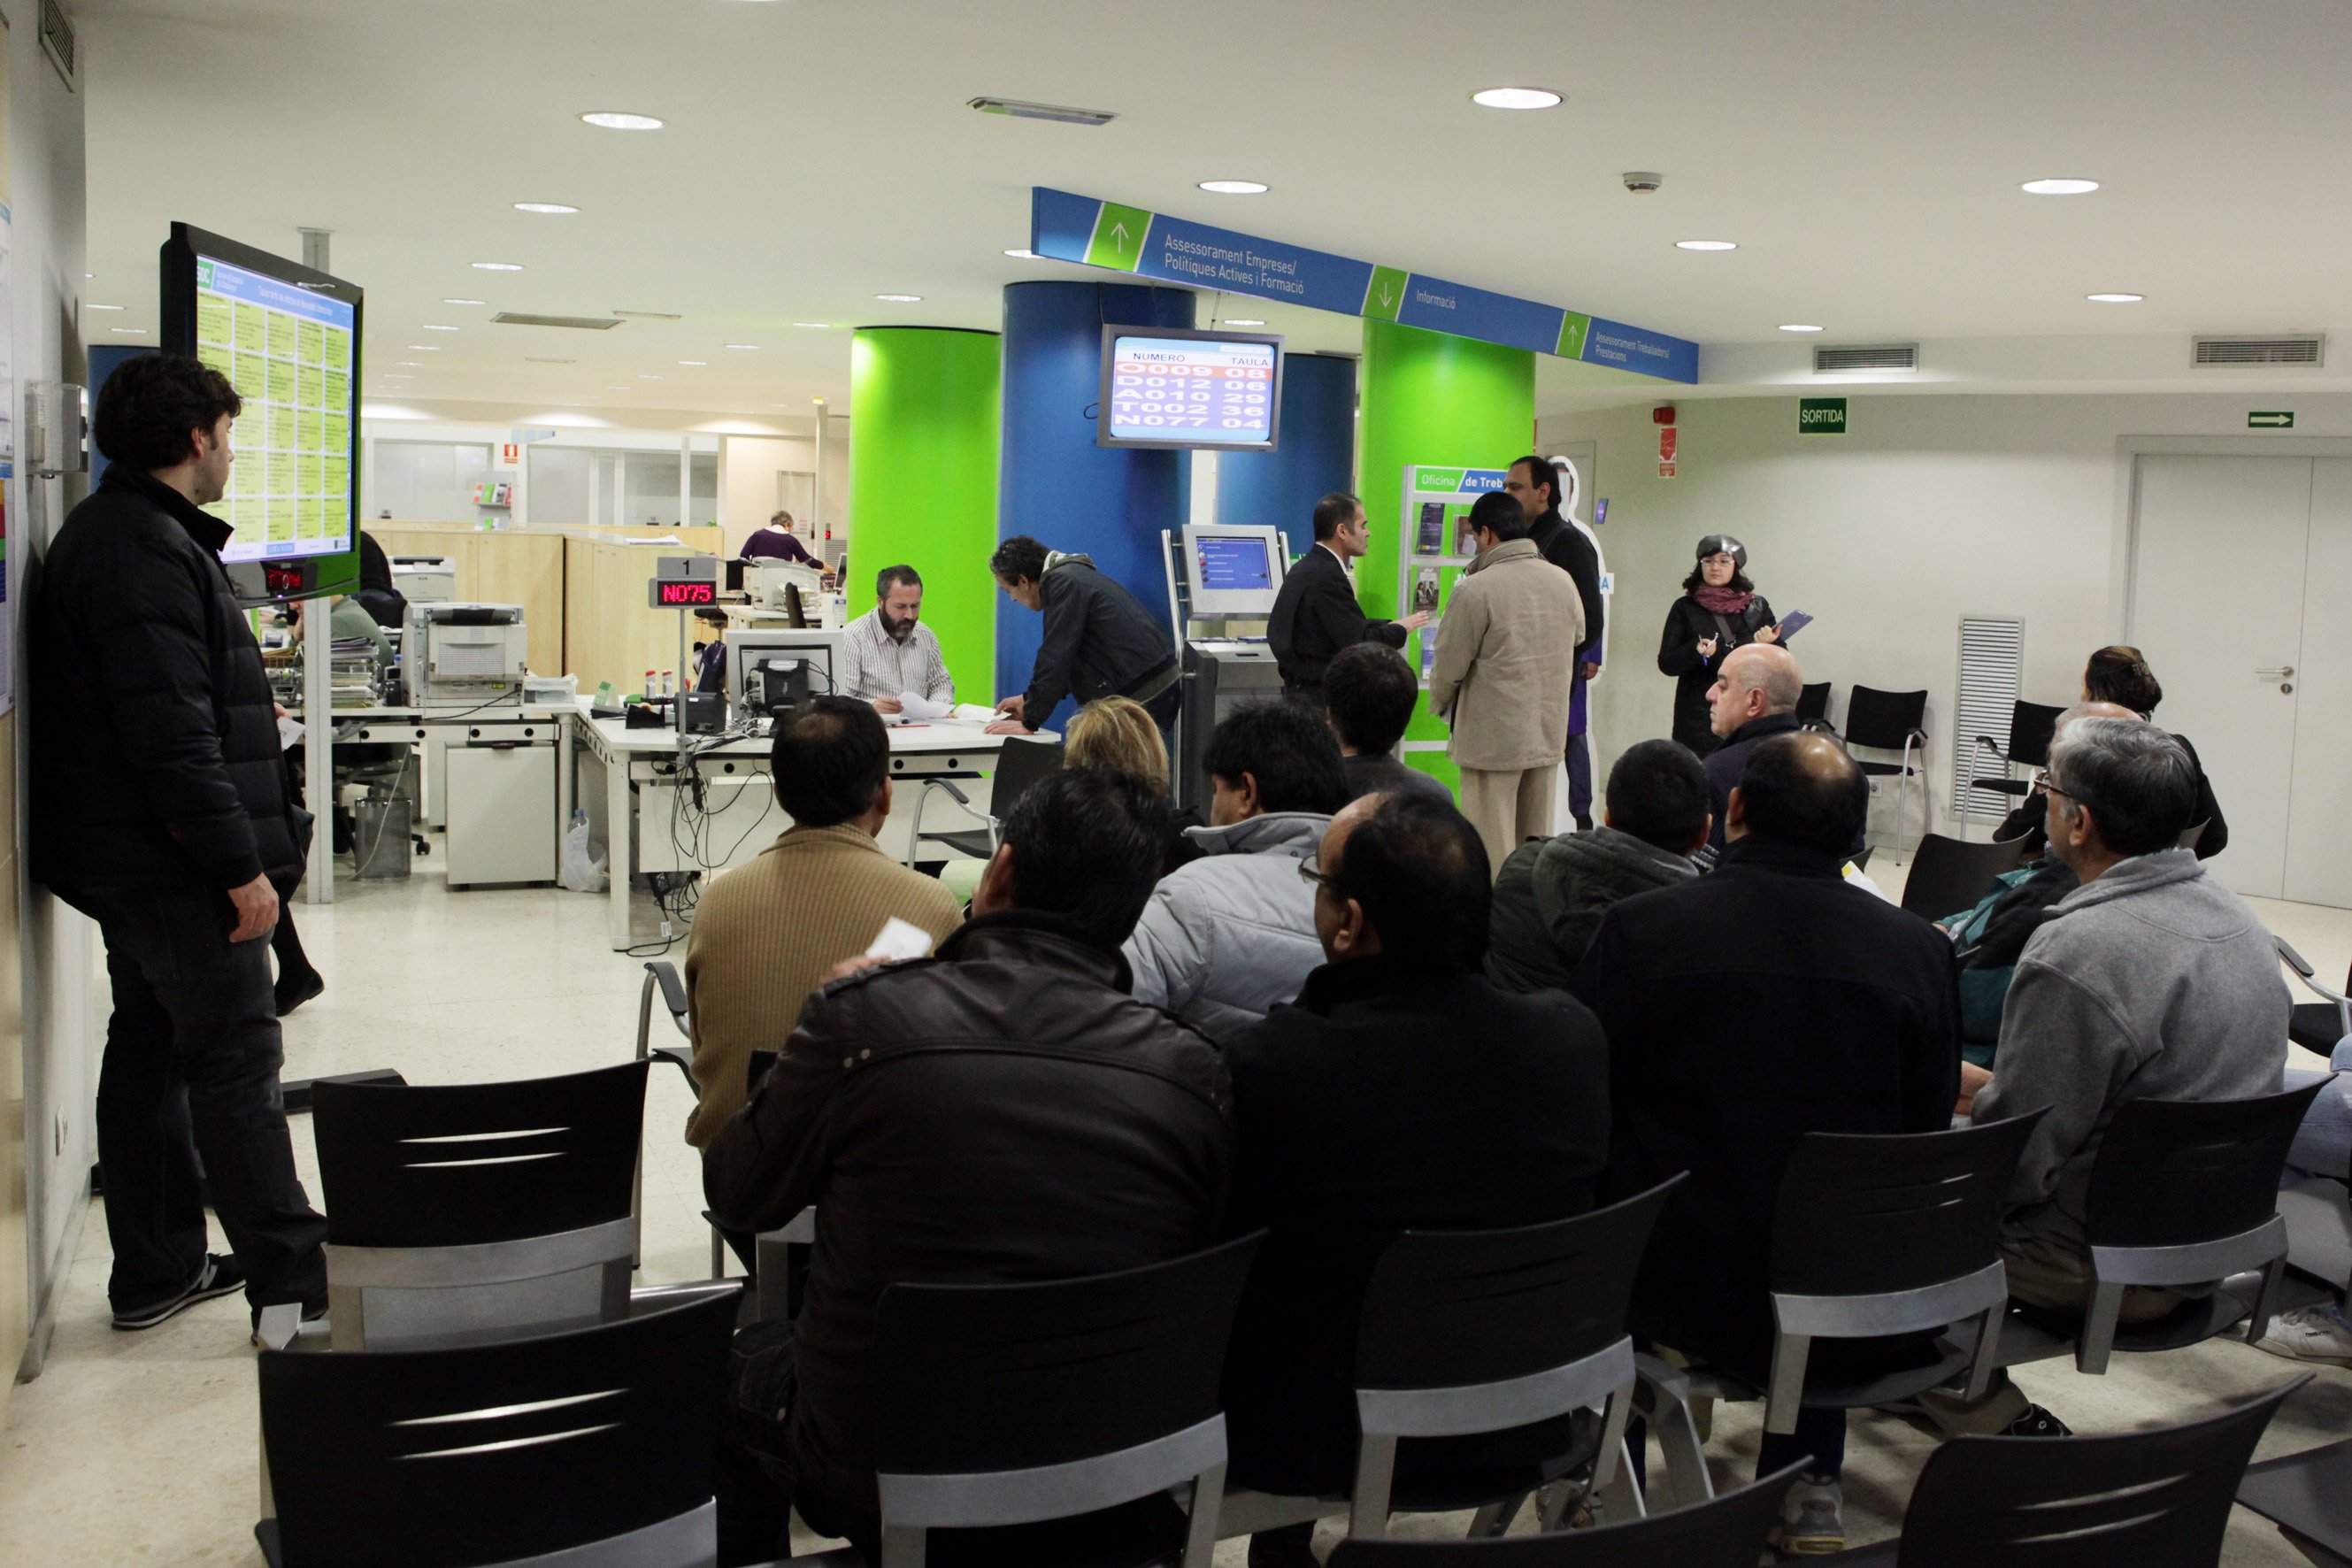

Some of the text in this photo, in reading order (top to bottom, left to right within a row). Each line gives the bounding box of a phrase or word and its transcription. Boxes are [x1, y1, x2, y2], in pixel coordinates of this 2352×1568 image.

[1164, 234, 1297, 275] Assessorament Empreses/
[1164, 253, 1217, 277] Polítiques
[1218, 265, 1254, 285] Actives
[1261, 273, 1304, 295] Formació
[1417, 289, 1457, 310] Informació
[1232, 357, 1269, 366] TAULA
[1224, 368, 1266, 379] 08
[1117, 376, 1266, 391] D012 06
[1115, 388, 1266, 404] A010 29
[1115, 402, 1264, 417] T002 36
[1802, 410, 1844, 423] SORTIDA
[1115, 414, 1264, 429] N077 04
[1422, 474, 1503, 488] Oficina de Treb
[682, 559, 689, 575] 1
